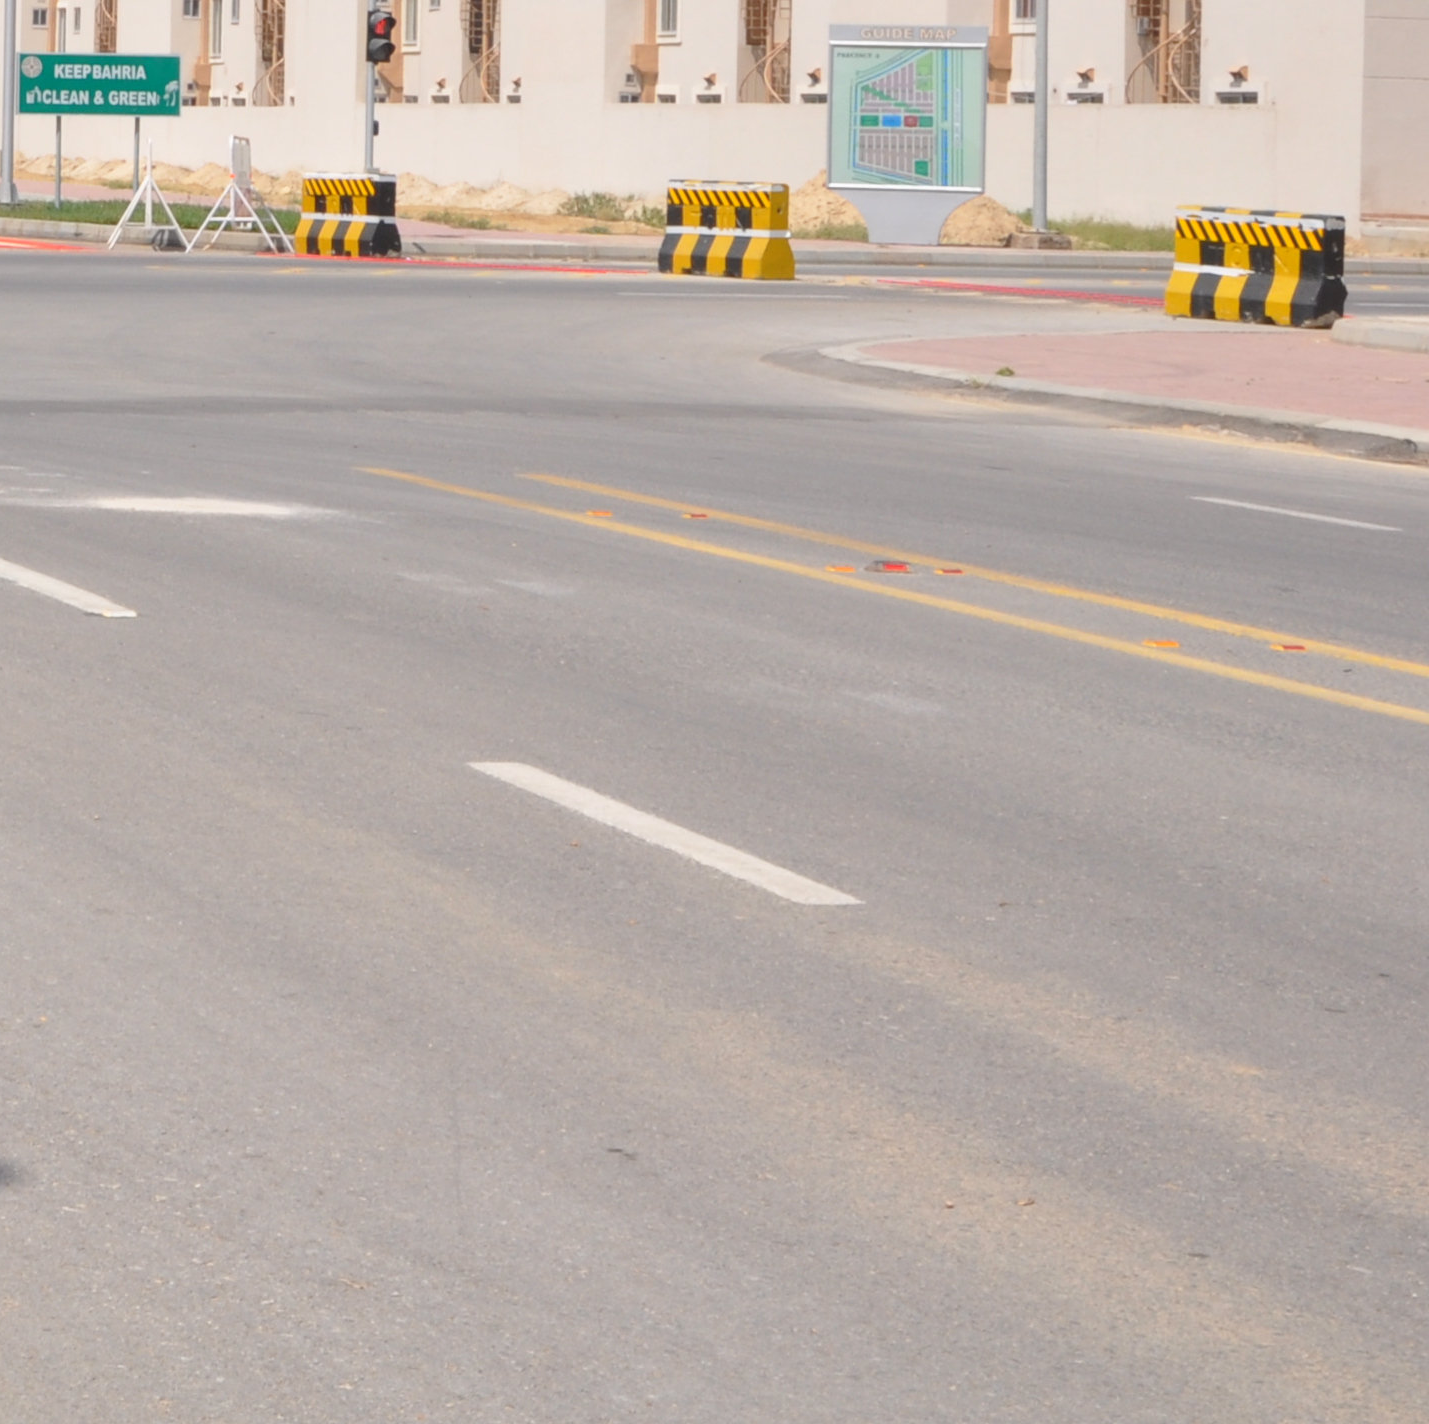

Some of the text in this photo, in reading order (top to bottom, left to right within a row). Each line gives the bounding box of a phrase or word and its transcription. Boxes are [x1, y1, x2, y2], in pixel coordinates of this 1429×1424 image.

[860, 27, 957, 40] GUIDE MAP
[42, 89, 158, 106] CLEAN & GREEN
